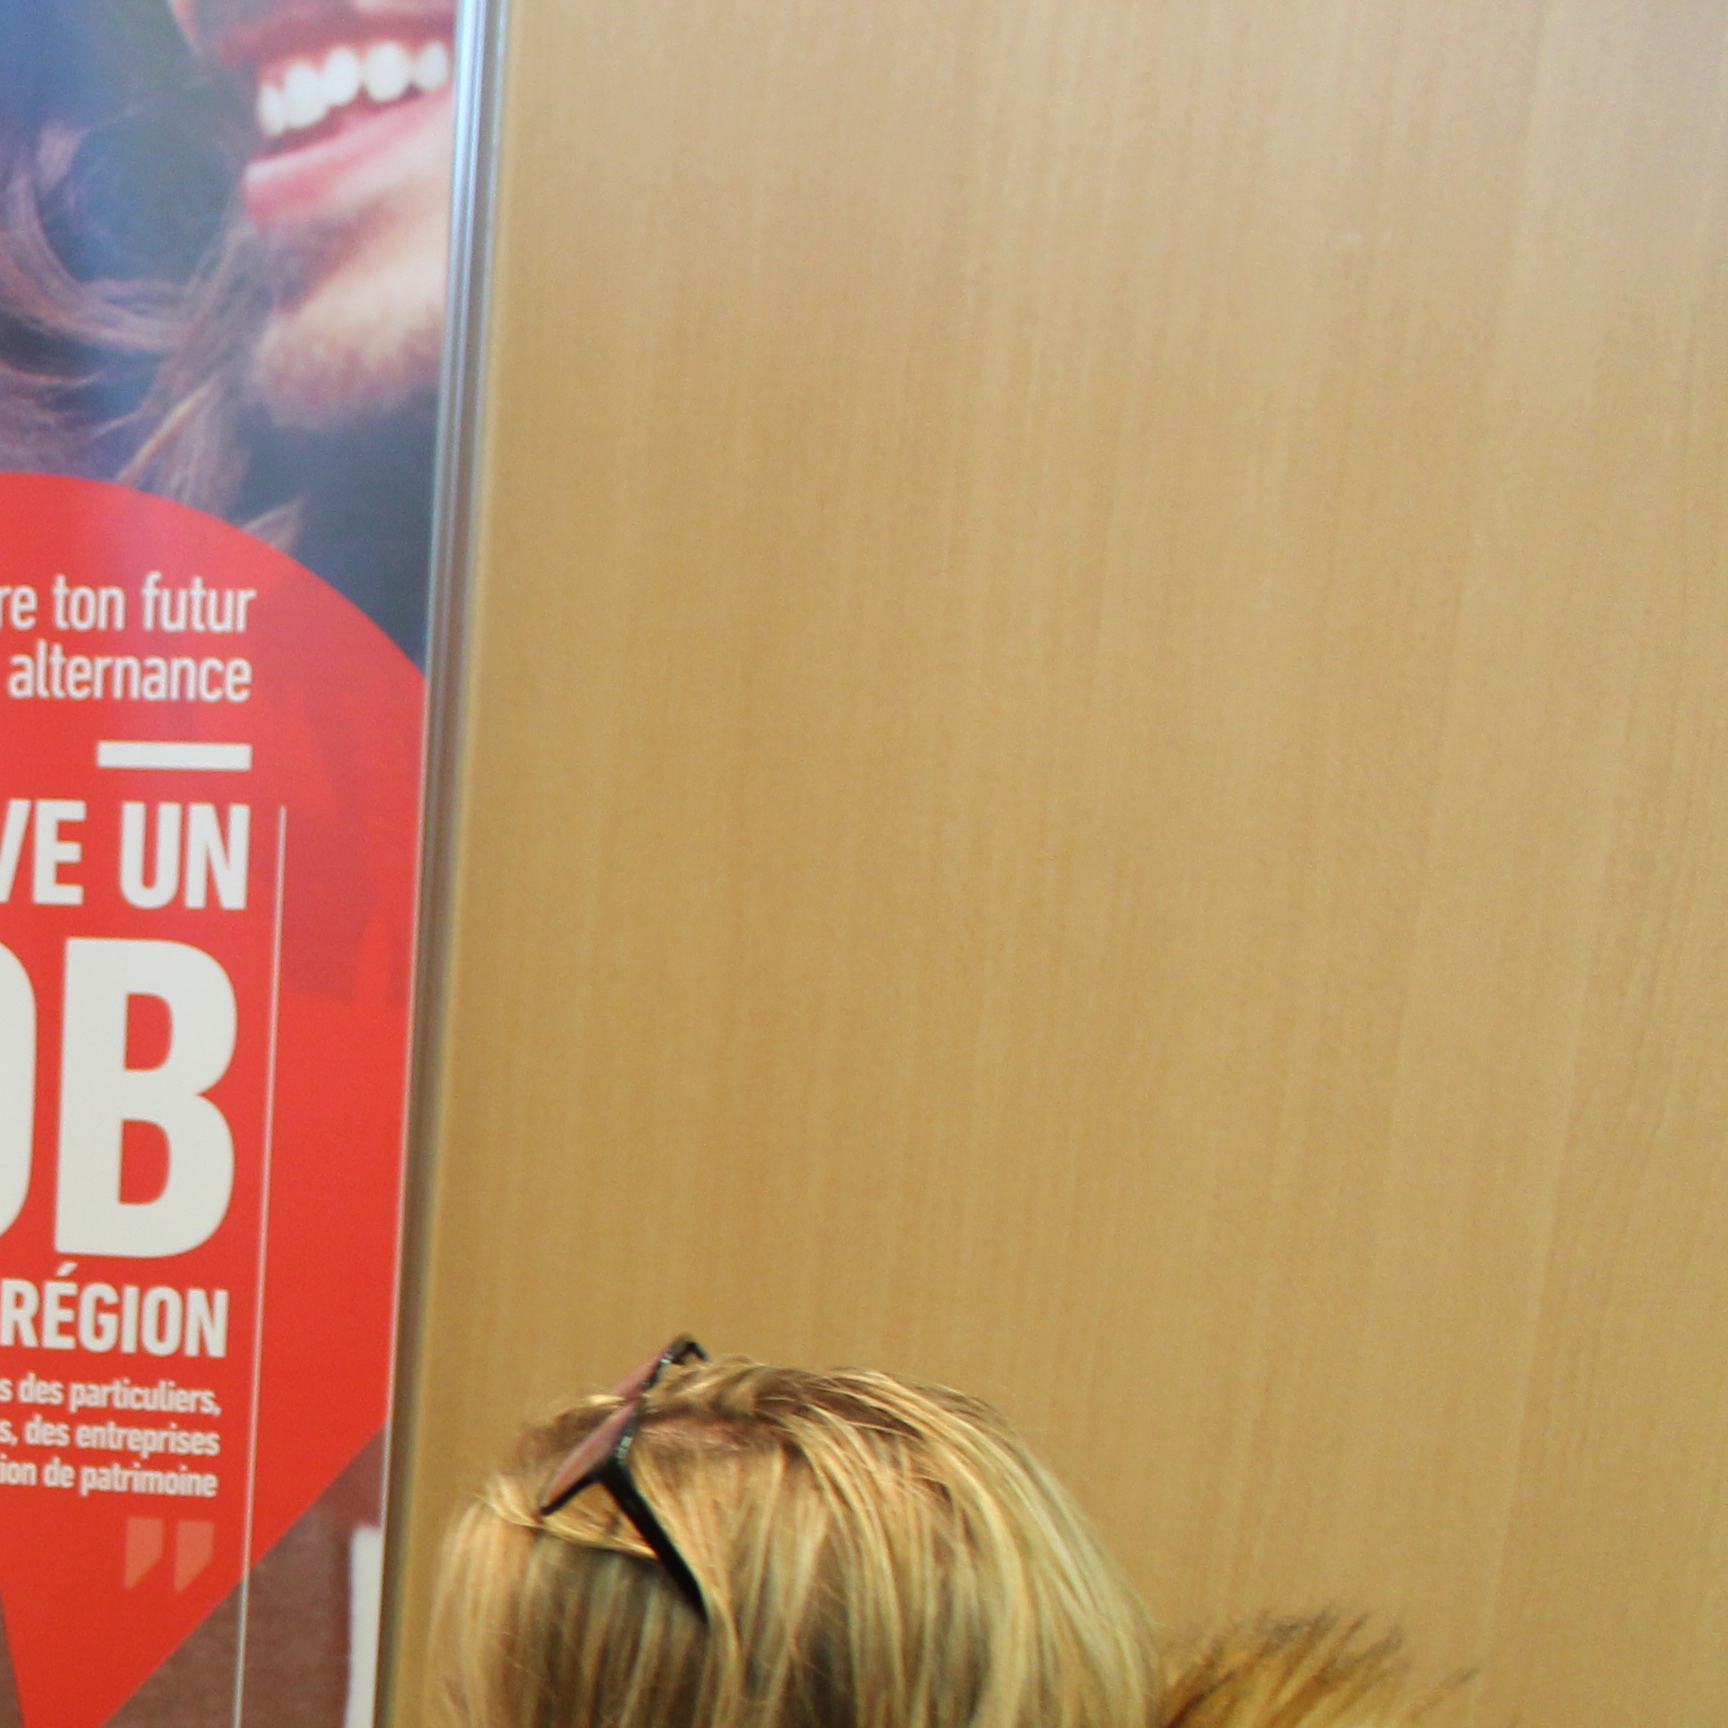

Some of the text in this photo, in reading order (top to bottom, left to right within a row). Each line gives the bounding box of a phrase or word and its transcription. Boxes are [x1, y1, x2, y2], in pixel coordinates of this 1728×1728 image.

[52, 574, 126, 631] ton
[141, 570, 257, 633] futur
[7, 639, 253, 703] alternance
[120, 801, 251, 910] UN
[17, 1372, 65, 1405] des
[68, 1378, 222, 1415] particuliers,
[23, 1413, 71, 1447] des
[74, 1420, 221, 1458] entreprises
[42, 1456, 76, 1489] de
[79, 1462, 218, 1498] patrimoine
